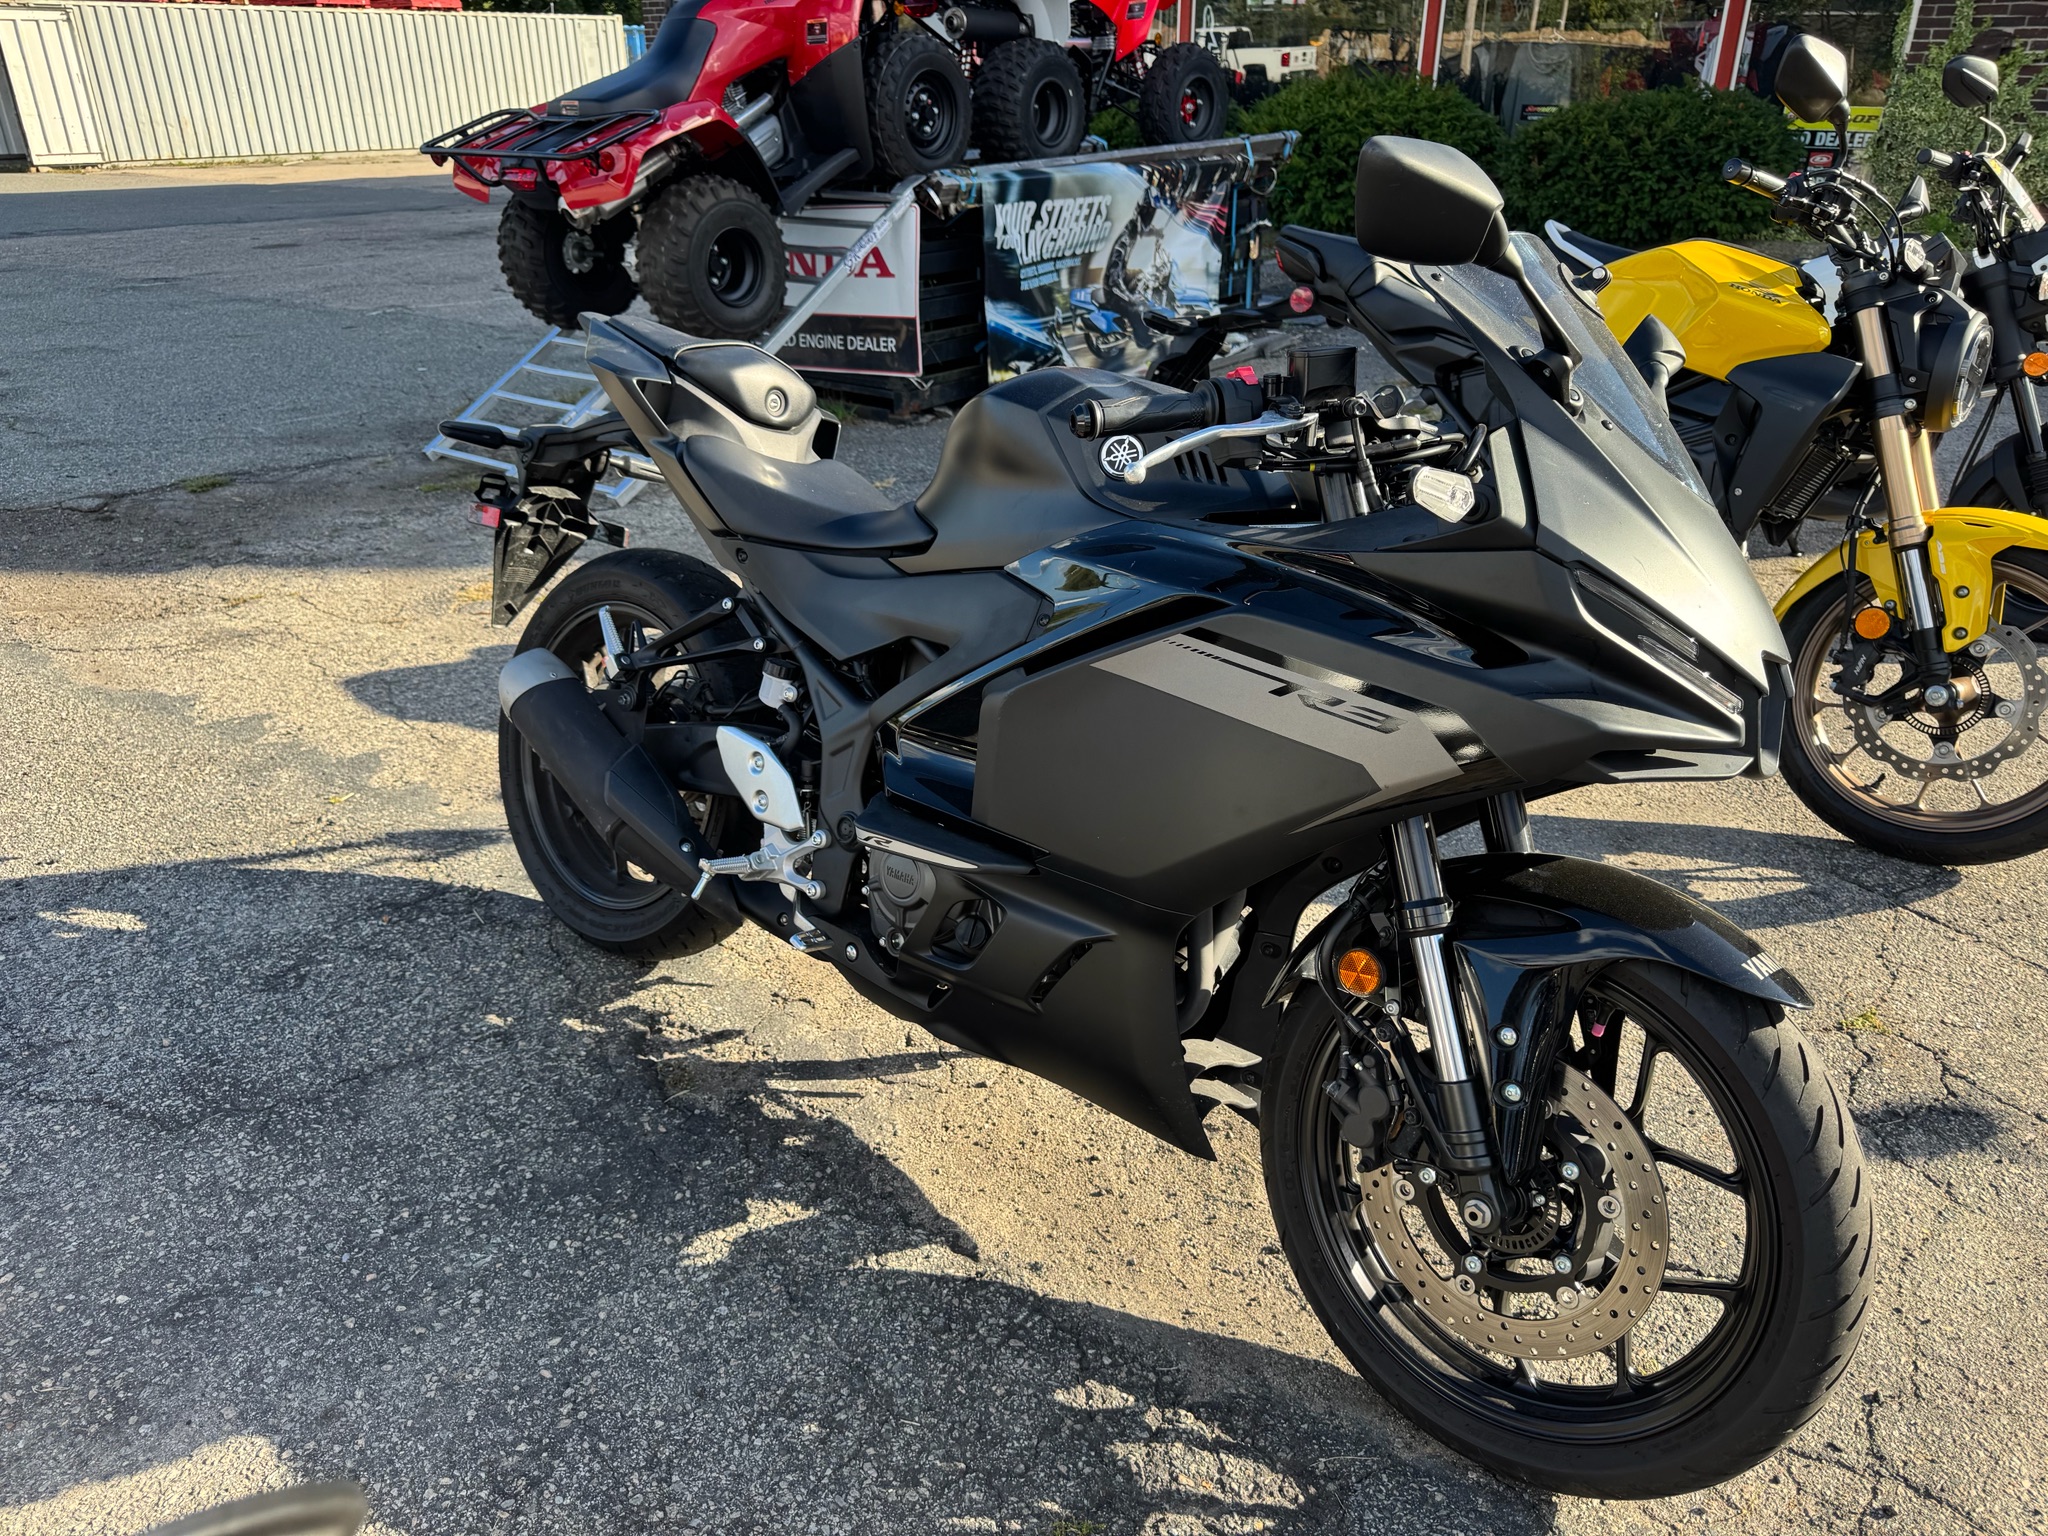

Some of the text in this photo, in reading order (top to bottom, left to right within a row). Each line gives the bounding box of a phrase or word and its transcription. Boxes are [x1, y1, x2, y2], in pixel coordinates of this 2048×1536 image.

[994, 200, 1037, 235] YOUR
[1728, 282, 1782, 304] HONDA
[798, 333, 845, 350] ENGINE
[846, 334, 897, 353] DEALER
[886, 865, 914, 886] YAMAHA
